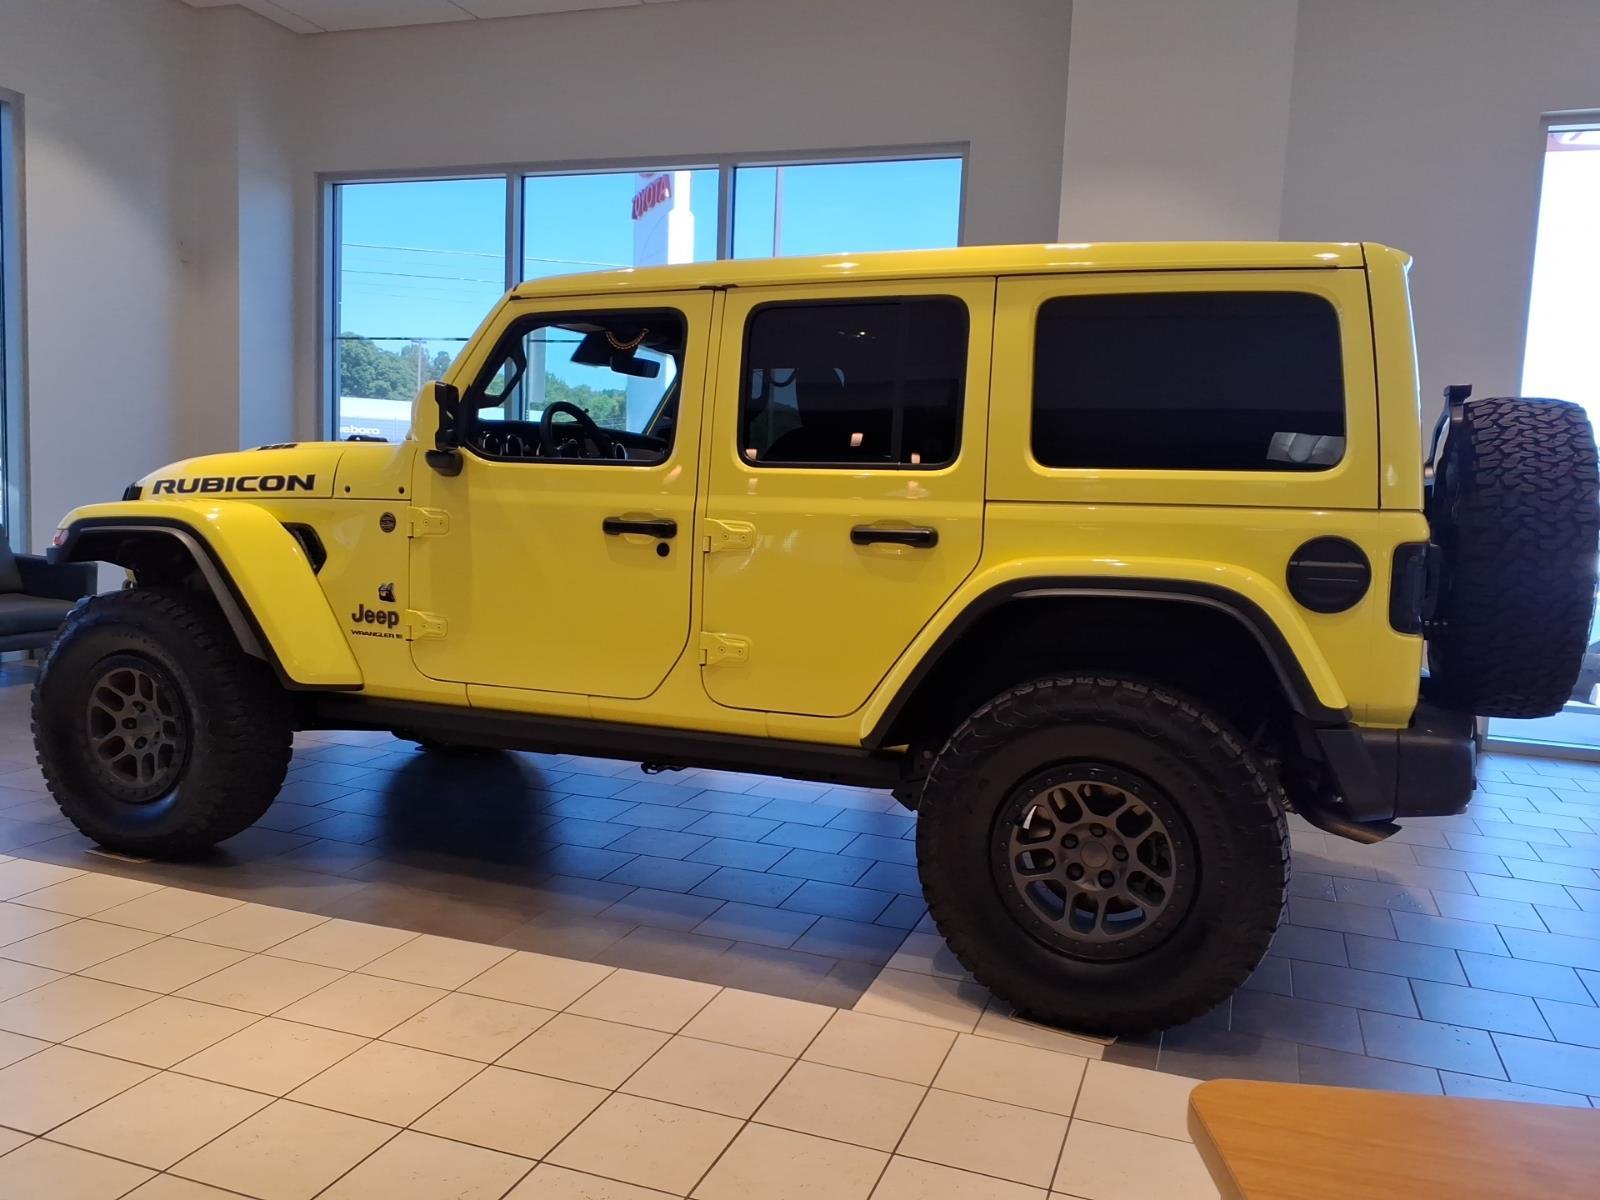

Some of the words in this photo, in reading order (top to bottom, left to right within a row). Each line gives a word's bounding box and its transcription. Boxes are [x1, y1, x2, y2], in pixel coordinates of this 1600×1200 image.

[632, 174, 672, 220] TOYOTA
[152, 474, 316, 495] RUBICON
[351, 603, 400, 629] Jeep
[351, 629, 395, 639] WRANGLER
